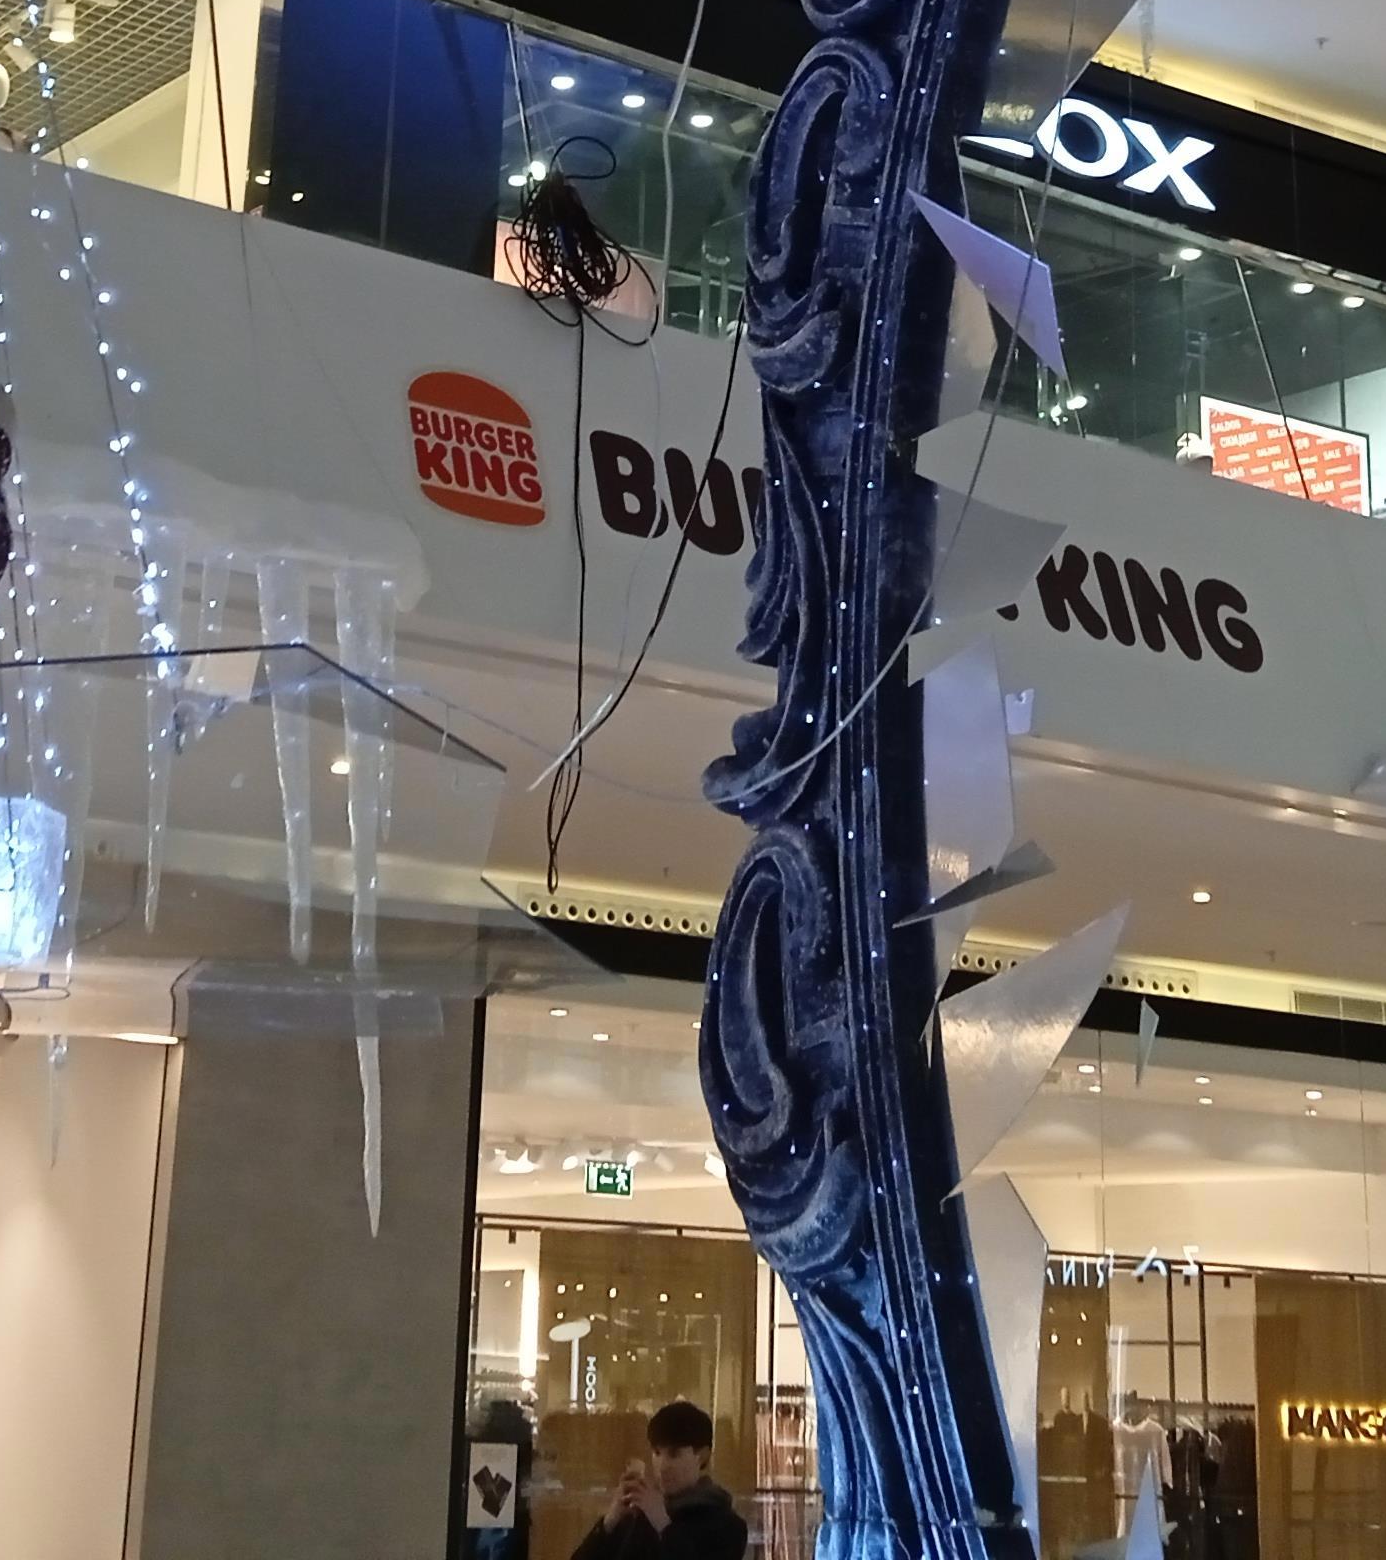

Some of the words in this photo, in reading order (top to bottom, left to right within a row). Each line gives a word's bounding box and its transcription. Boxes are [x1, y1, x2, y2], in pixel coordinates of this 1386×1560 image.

[960, 97, 1216, 212] OX
[409, 405, 537, 462] BURGER
[414, 437, 543, 503] KING
[1036, 544, 1263, 673] KING
